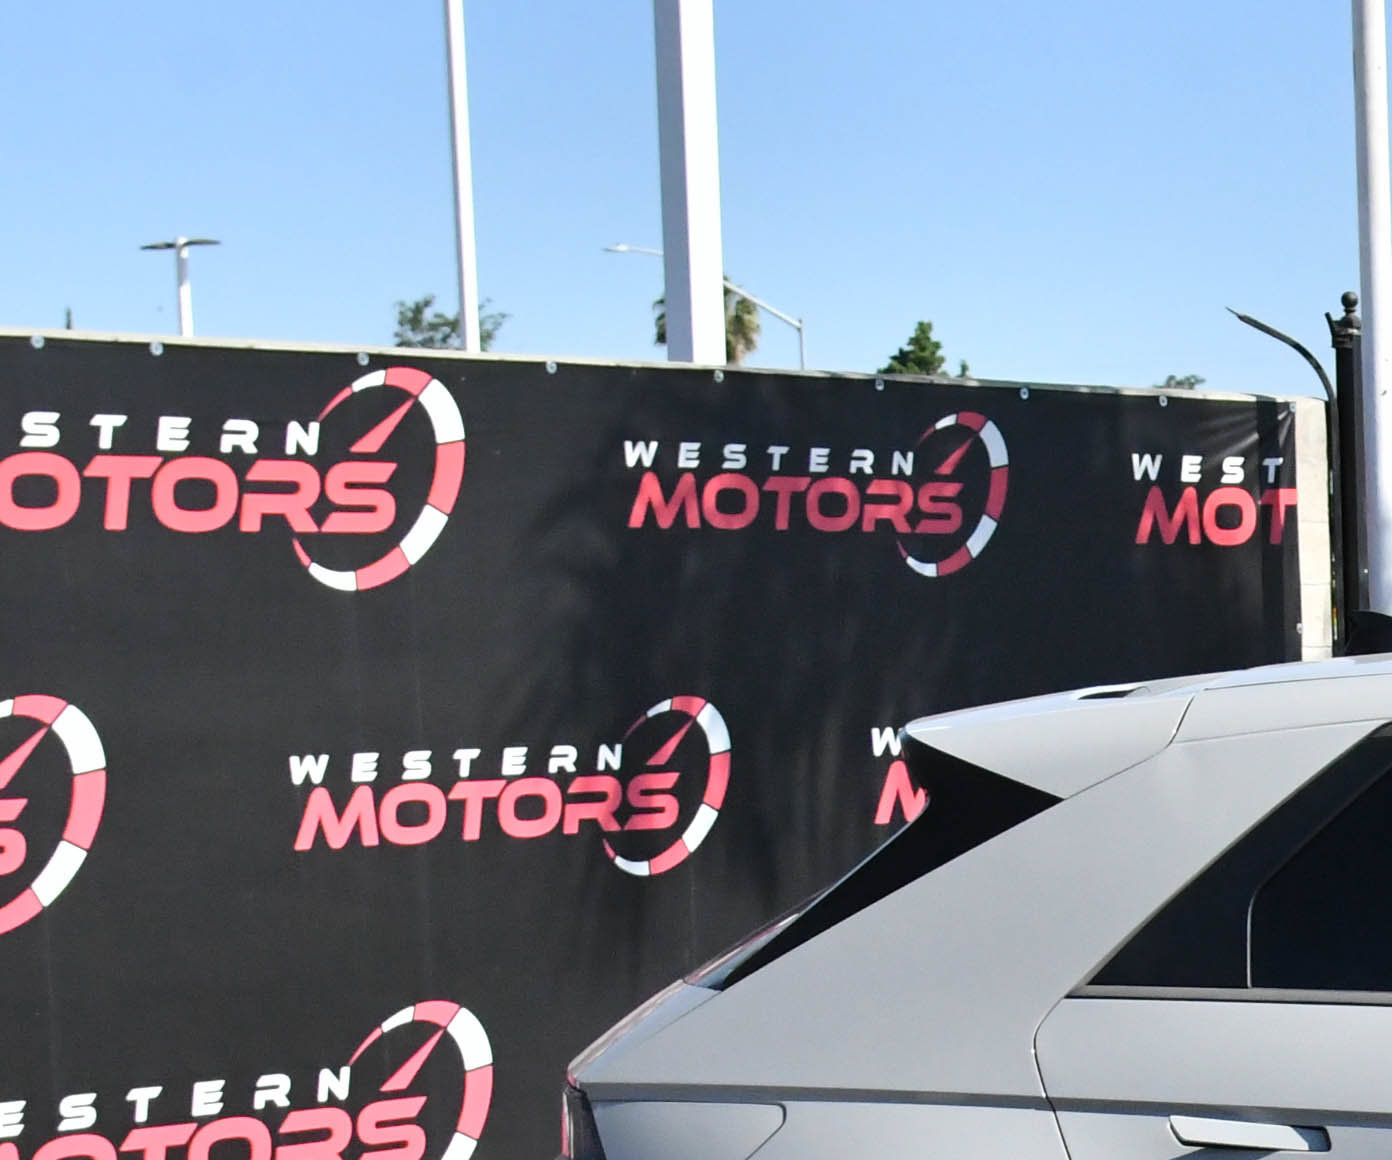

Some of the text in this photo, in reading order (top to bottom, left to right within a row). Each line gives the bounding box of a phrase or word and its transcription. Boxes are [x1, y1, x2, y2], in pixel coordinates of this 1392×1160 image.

[18, 411, 321, 455] STERN
[624, 441, 914, 475] WESTERN
[1131, 453, 1284, 484] WEST
[628, 473, 964, 534] MOTORS
[1135, 485, 1298, 546] MOT
[289, 744, 622, 785] WESTERN
[294, 772, 680, 851] MOTORS
